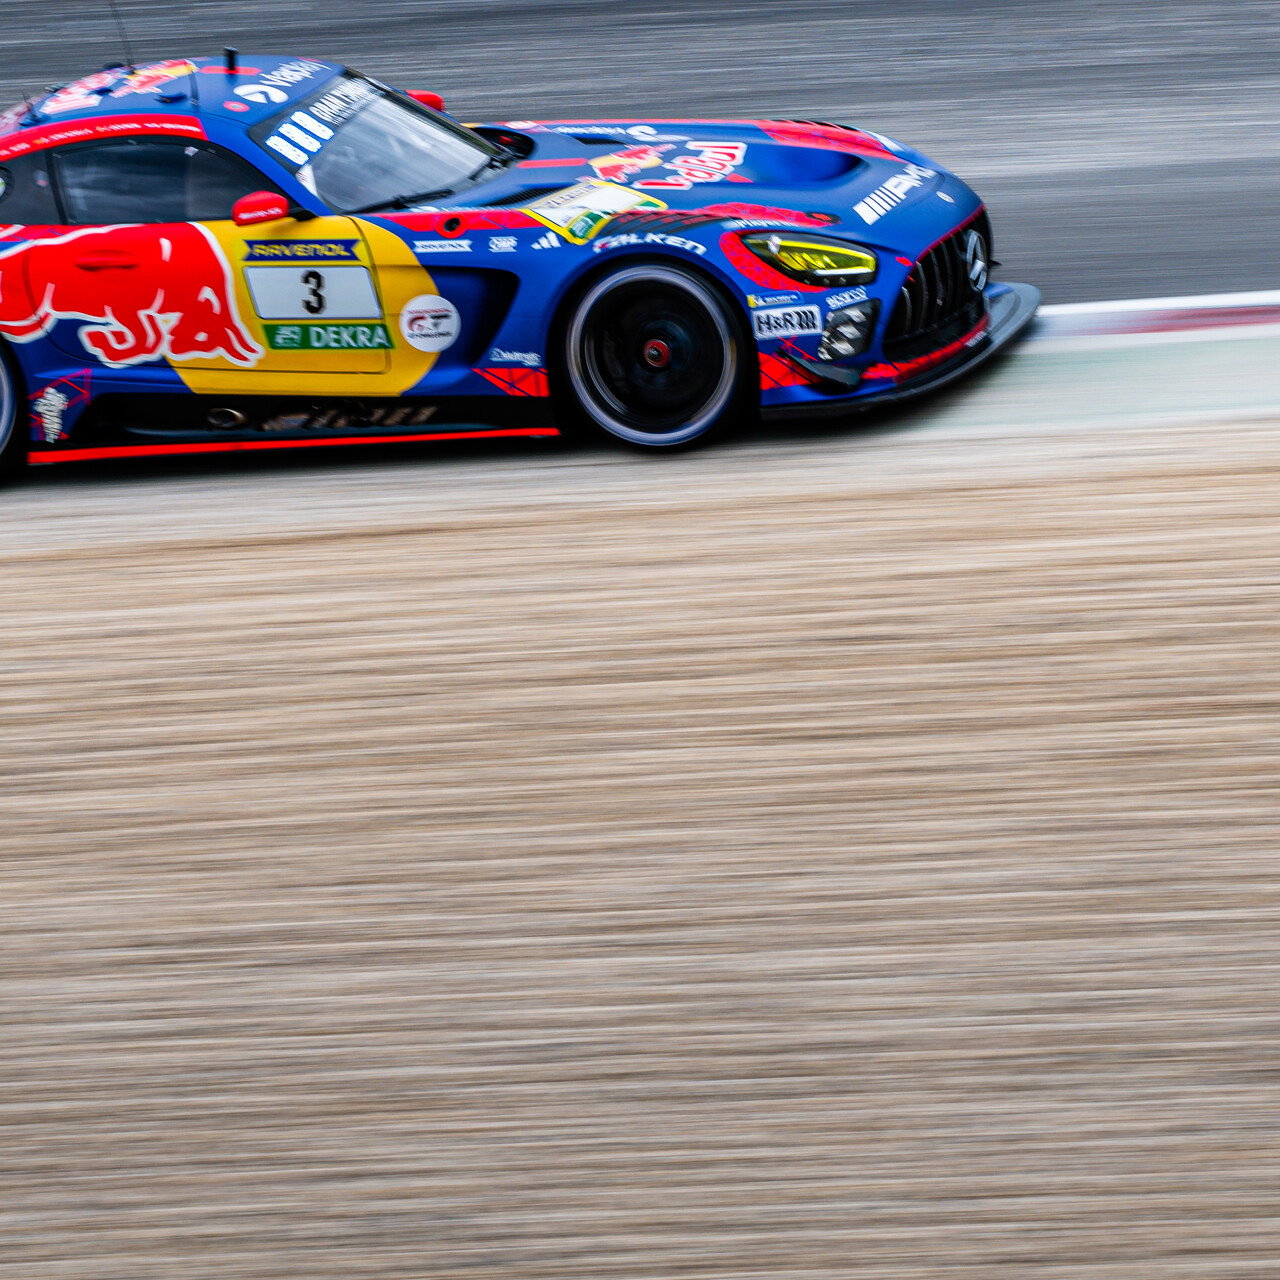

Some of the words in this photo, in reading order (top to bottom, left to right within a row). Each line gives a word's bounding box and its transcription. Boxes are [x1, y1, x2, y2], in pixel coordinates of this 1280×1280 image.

[249, 243, 351, 257] RAVENOL
[592, 232, 708, 256] FALKEN
[300, 269, 326, 315] 3
[308, 325, 394, 348] DEKRA
